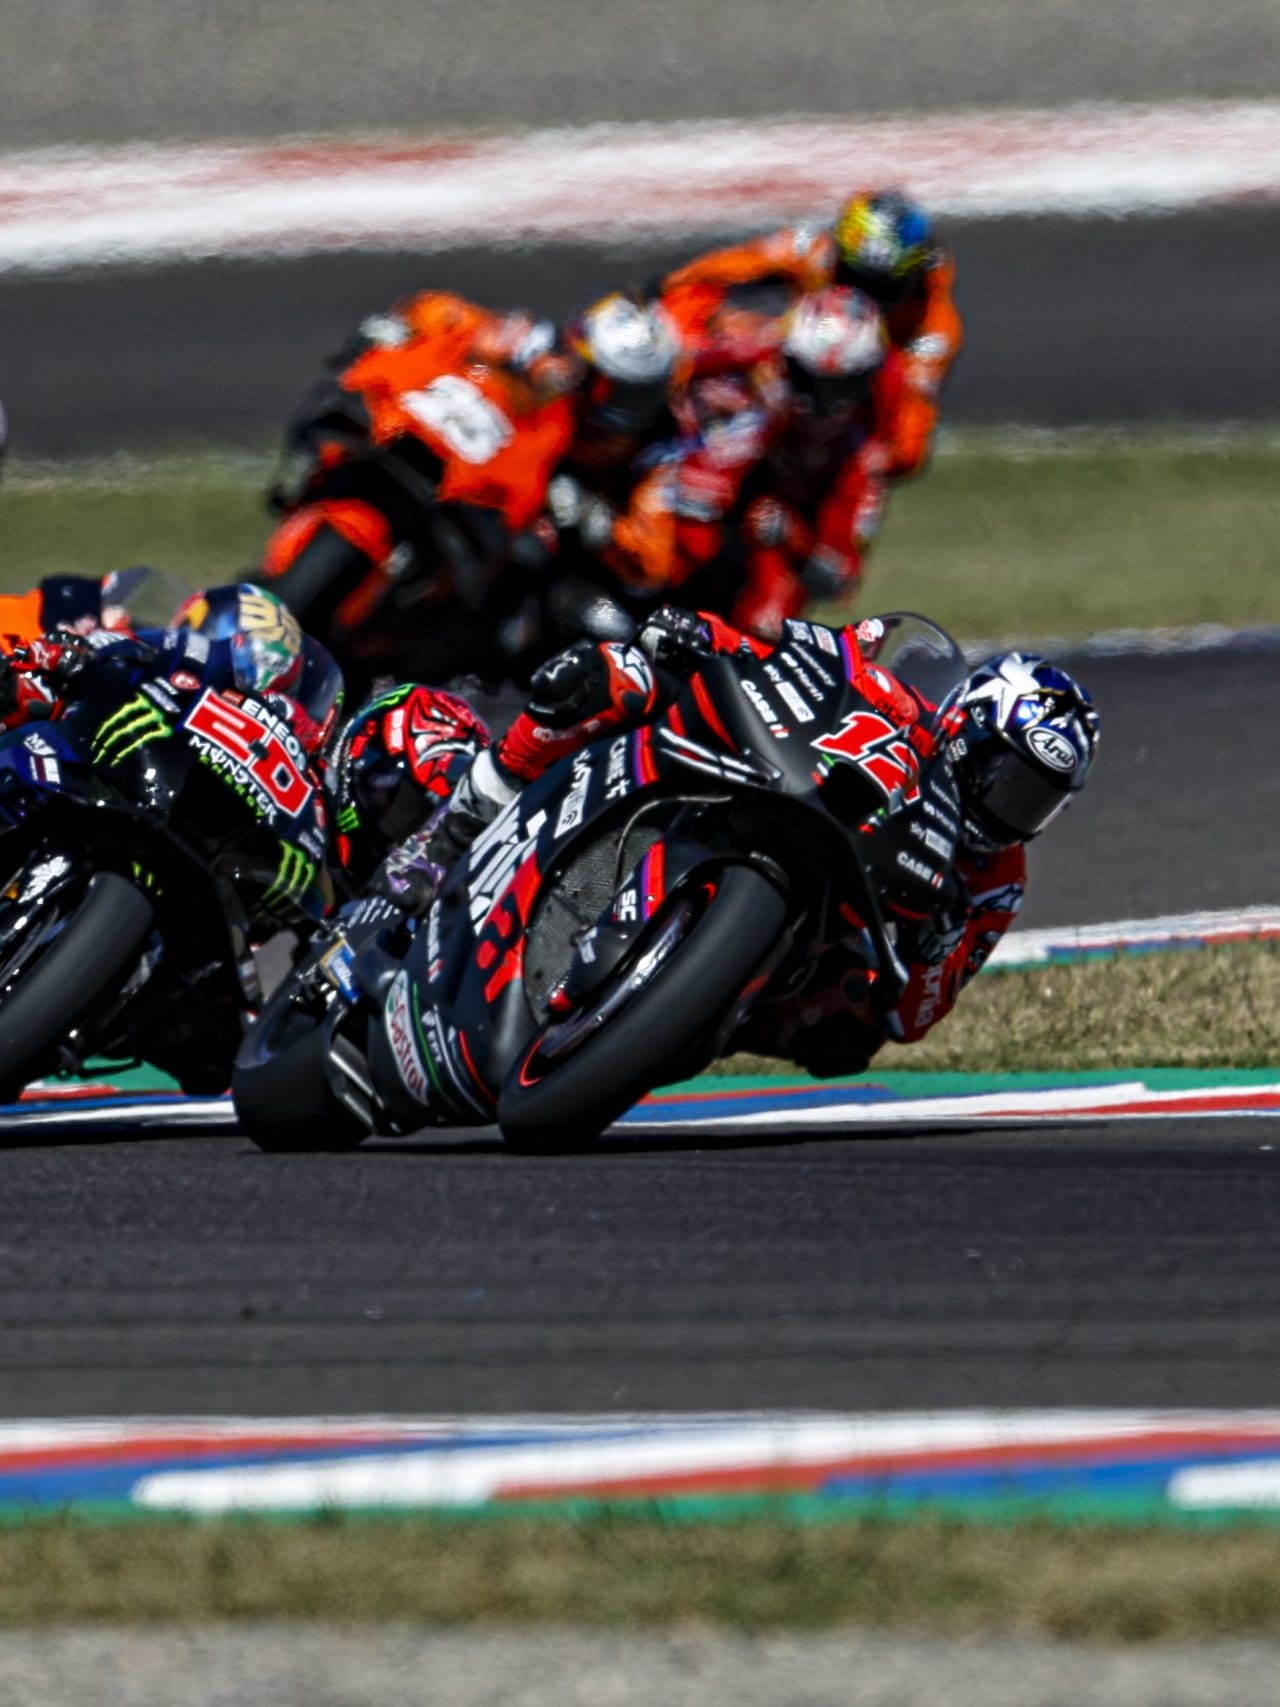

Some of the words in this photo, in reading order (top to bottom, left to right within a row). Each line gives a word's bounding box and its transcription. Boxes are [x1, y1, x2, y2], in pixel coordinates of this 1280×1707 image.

[740, 680, 778, 723] CASE
[241, 697, 306, 772] ENEOS
[1034, 731, 1076, 769] Arai
[189, 734, 278, 825] MONSTER
